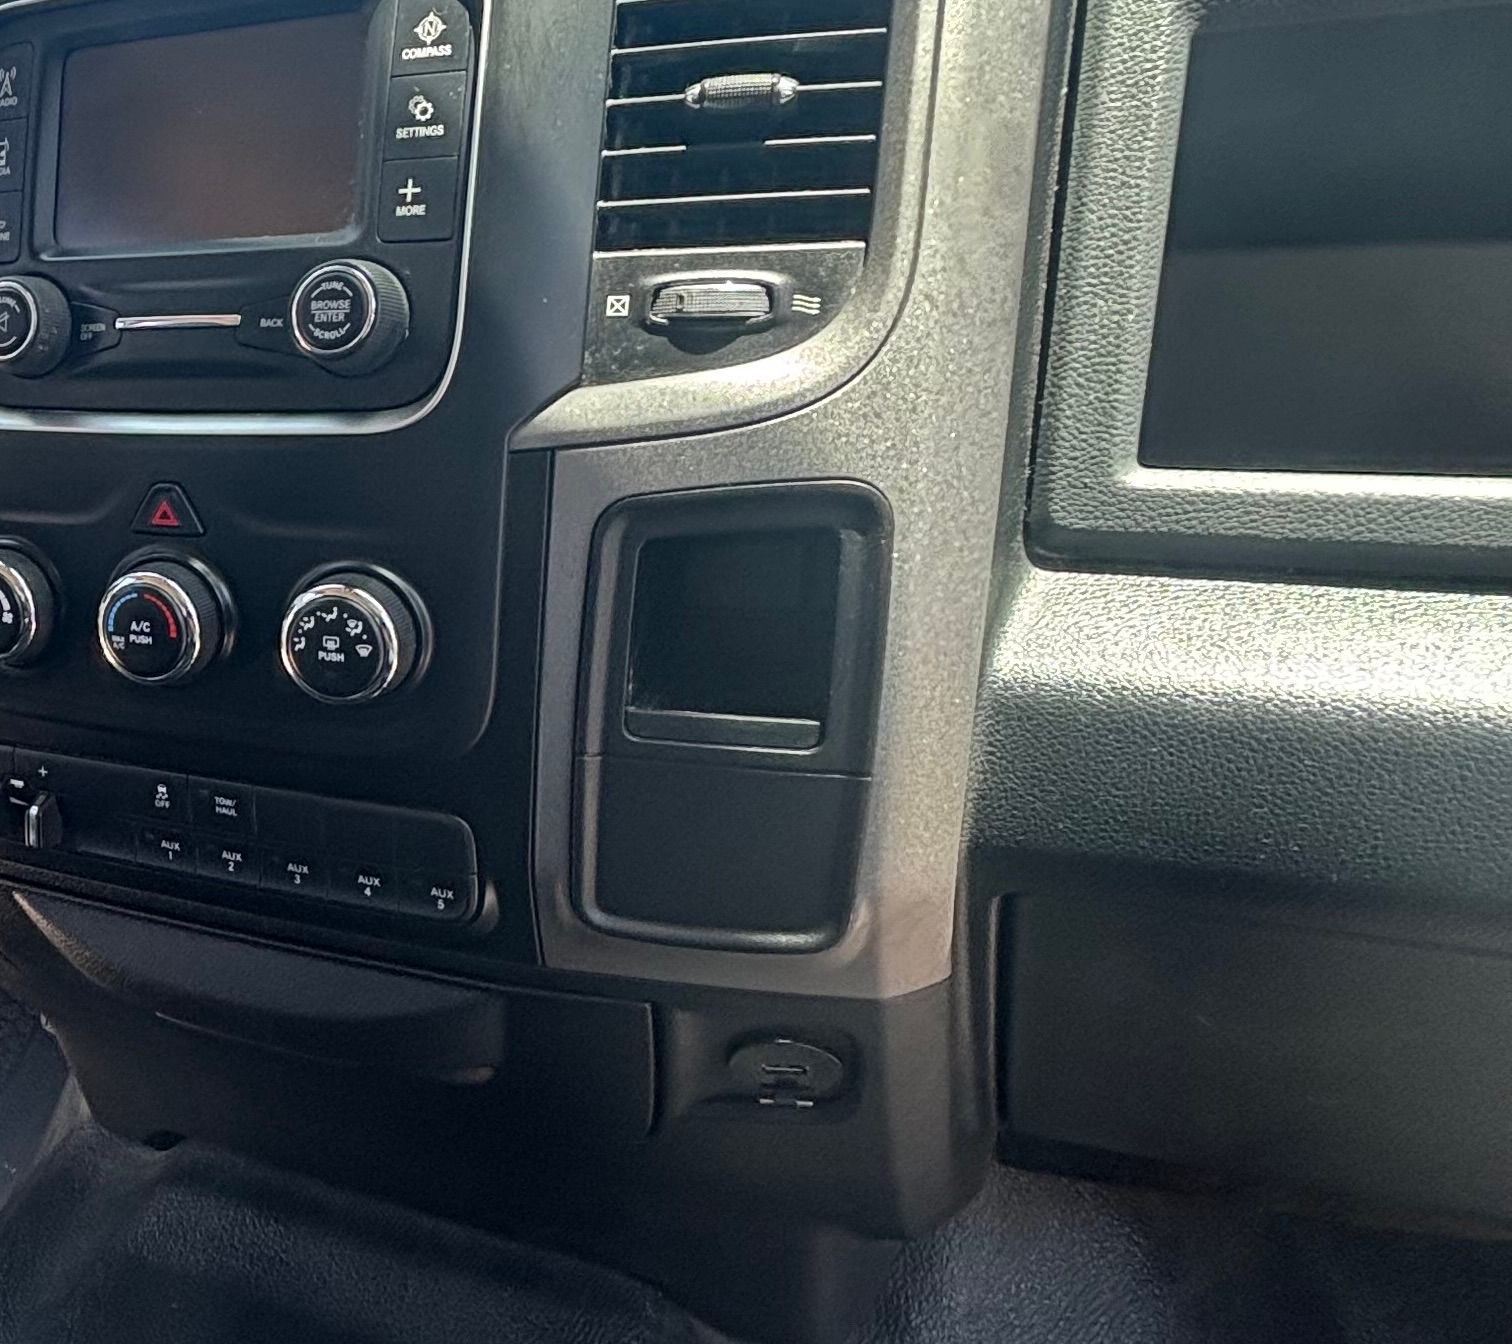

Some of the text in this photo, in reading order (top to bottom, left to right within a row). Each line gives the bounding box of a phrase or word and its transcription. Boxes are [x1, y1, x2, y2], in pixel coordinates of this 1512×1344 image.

[401, 44, 452, 60] COMPASS
[395, 125, 445, 139] SETTINGS
[395, 205, 426, 217] MORE
[321, 281, 344, 290] TUNE
[311, 299, 351, 310] BROWSE
[260, 318, 284, 327] BACK
[314, 312, 345, 323] ENTER
[313, 328, 346, 339] SCROLL
[130, 621, 151, 633] A/C
[129, 634, 153, 645] PUSH
[317, 650, 345, 662] PUSH
[154, 799, 170, 808] OFF
[214, 796, 237, 807] TOW/
[215, 806, 238, 817] HAUL
[161, 840, 181, 851] AUX
[168, 851, 173, 860] 1
[221, 850, 242, 862] AUX
[228, 861, 234, 872] 2
[287, 862, 309, 875] AUX
[294, 874, 301, 884] 3
[357, 875, 381, 887] AUX
[363, 887, 371, 897] 4
[430, 887, 454, 899] AUX
[437, 899, 445, 910] 5
